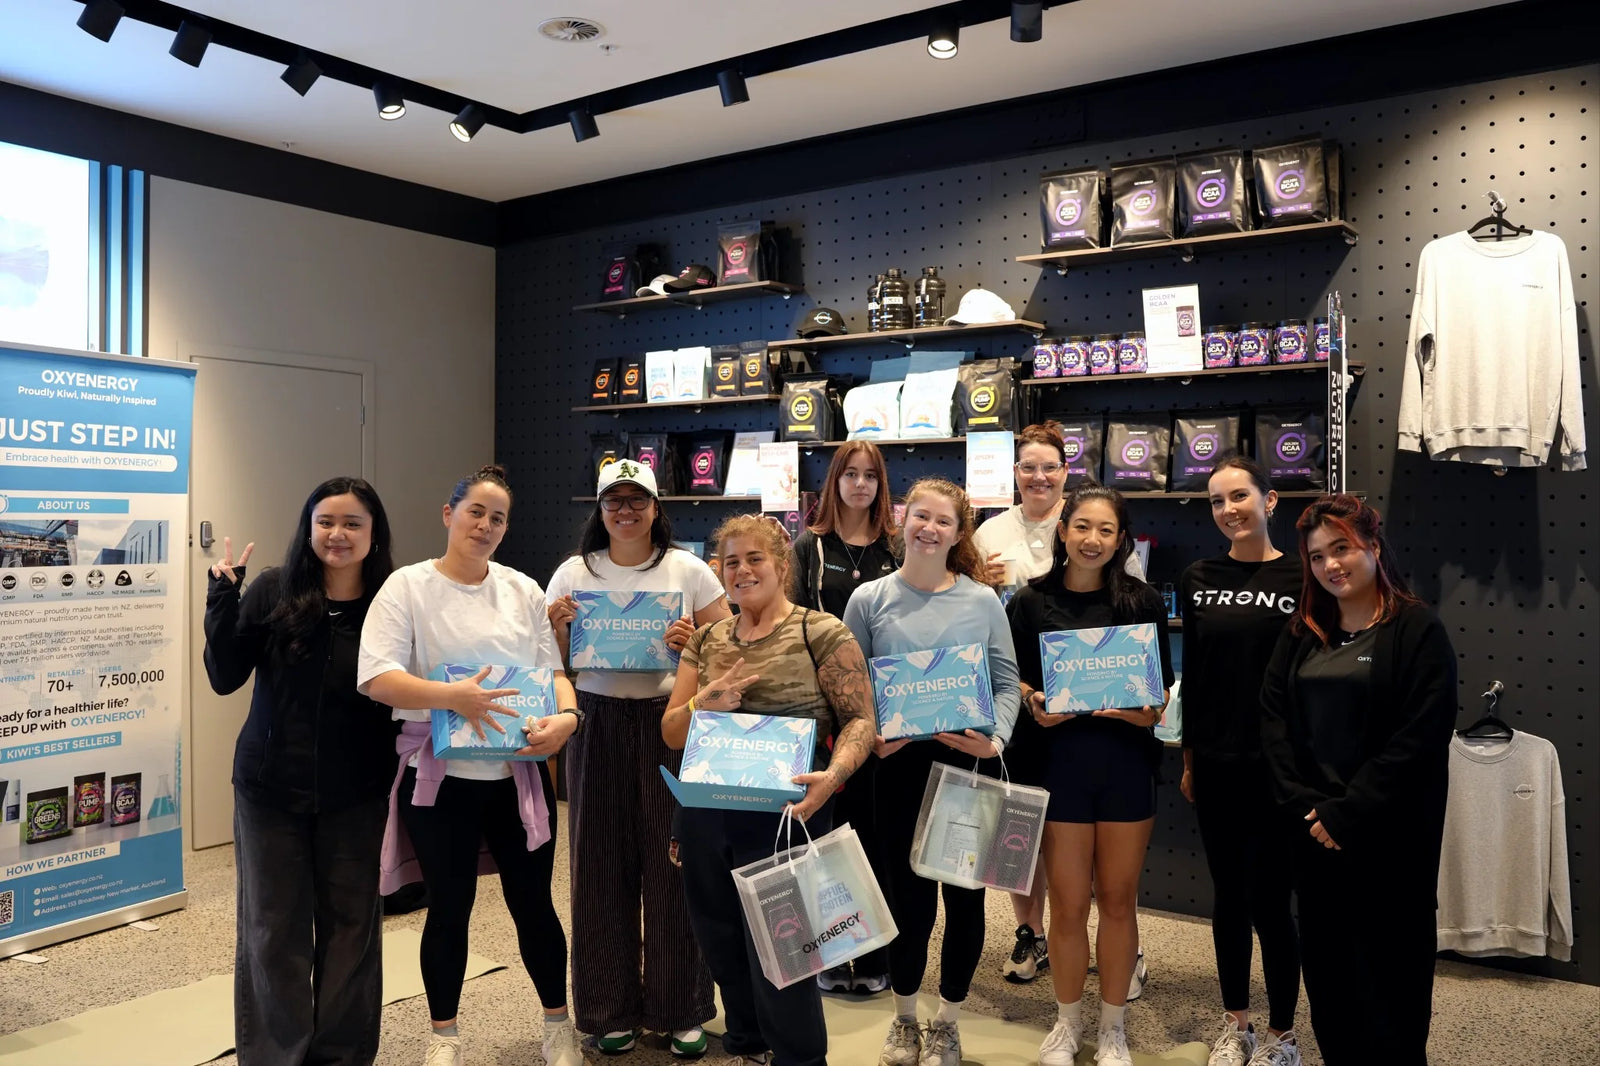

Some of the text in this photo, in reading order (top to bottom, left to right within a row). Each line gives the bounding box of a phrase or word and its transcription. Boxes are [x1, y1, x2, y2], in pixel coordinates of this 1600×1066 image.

[1280, 182, 1300, 190] BCAA
[1149, 293, 1176, 301] GOLDEN
[41, 369, 139, 392] OXYENERGY
[18, 386, 157, 406] Proudly Kiwi, Naturally Inspired
[0, 417, 176, 450] JUST STEP IN!
[5, 452, 48, 462] Embrace
[50, 454, 79, 464] health
[81, 455, 101, 465] with
[37, 501, 91, 511] ABOUT US
[1192, 589, 1296, 615] STRONG
[44, 607, 71, 616] proudly
[49, 614, 79, 622] nutrition
[581, 618, 672, 631] OXYENERGY
[14, 632, 43, 640] certified
[54, 628, 97, 637] international
[98, 626, 133, 634] authorities
[1053, 653, 1148, 673] OXYENERGY
[47, 668, 86, 678] RETAILERS
[98, 669, 165, 689] 7,500,000
[47, 679, 74, 693] 70+
[883, 673, 978, 698] OXYENERGY
[491, 694, 547, 708] NERGY
[26, 709, 43, 720] for
[44, 708, 51, 717] a
[54, 700, 106, 716] healthier
[107, 697, 129, 710] life?
[21, 723, 38, 735] UP
[40, 719, 67, 732] with
[71, 709, 146, 728] OXYENERGY!
[6, 734, 116, 760] KIWI'S BEST SELLERS
[698, 735, 801, 754] OXYENERGY
[78, 798, 100, 808] PUMP
[116, 799, 135, 807] BCAA
[712, 793, 773, 804] OXYENERGY
[34, 812, 61, 824] GREENS
[1006, 807, 1039, 819] OXYENERGY
[6, 847, 106, 878] HOW WE PARTNER
[141, 877, 167, 889] Auckland
[759, 888, 794, 906] OXYENERGY
[802, 911, 861, 954] OXYENERGY
